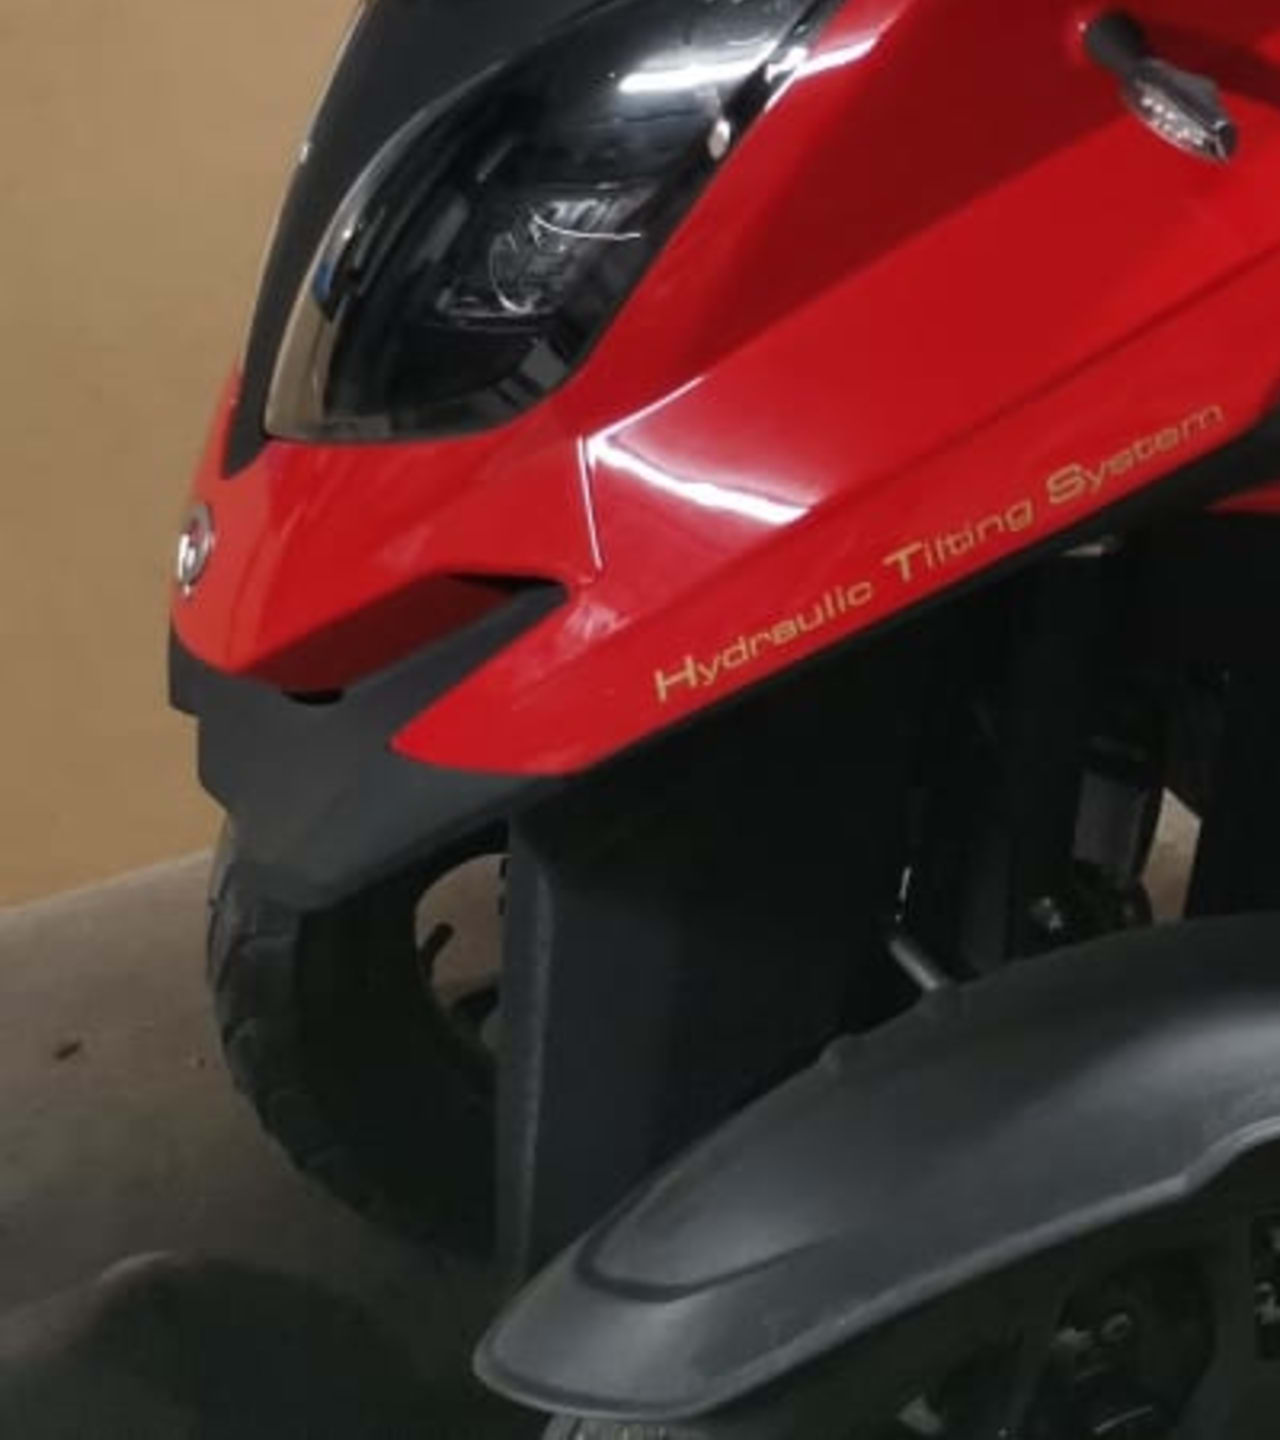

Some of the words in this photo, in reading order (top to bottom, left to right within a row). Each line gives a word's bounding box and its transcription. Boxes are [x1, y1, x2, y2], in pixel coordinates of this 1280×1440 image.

[654, 580, 874, 702] Hydraulic
[882, 498, 1034, 583] Tilting
[1045, 404, 1224, 505] System
